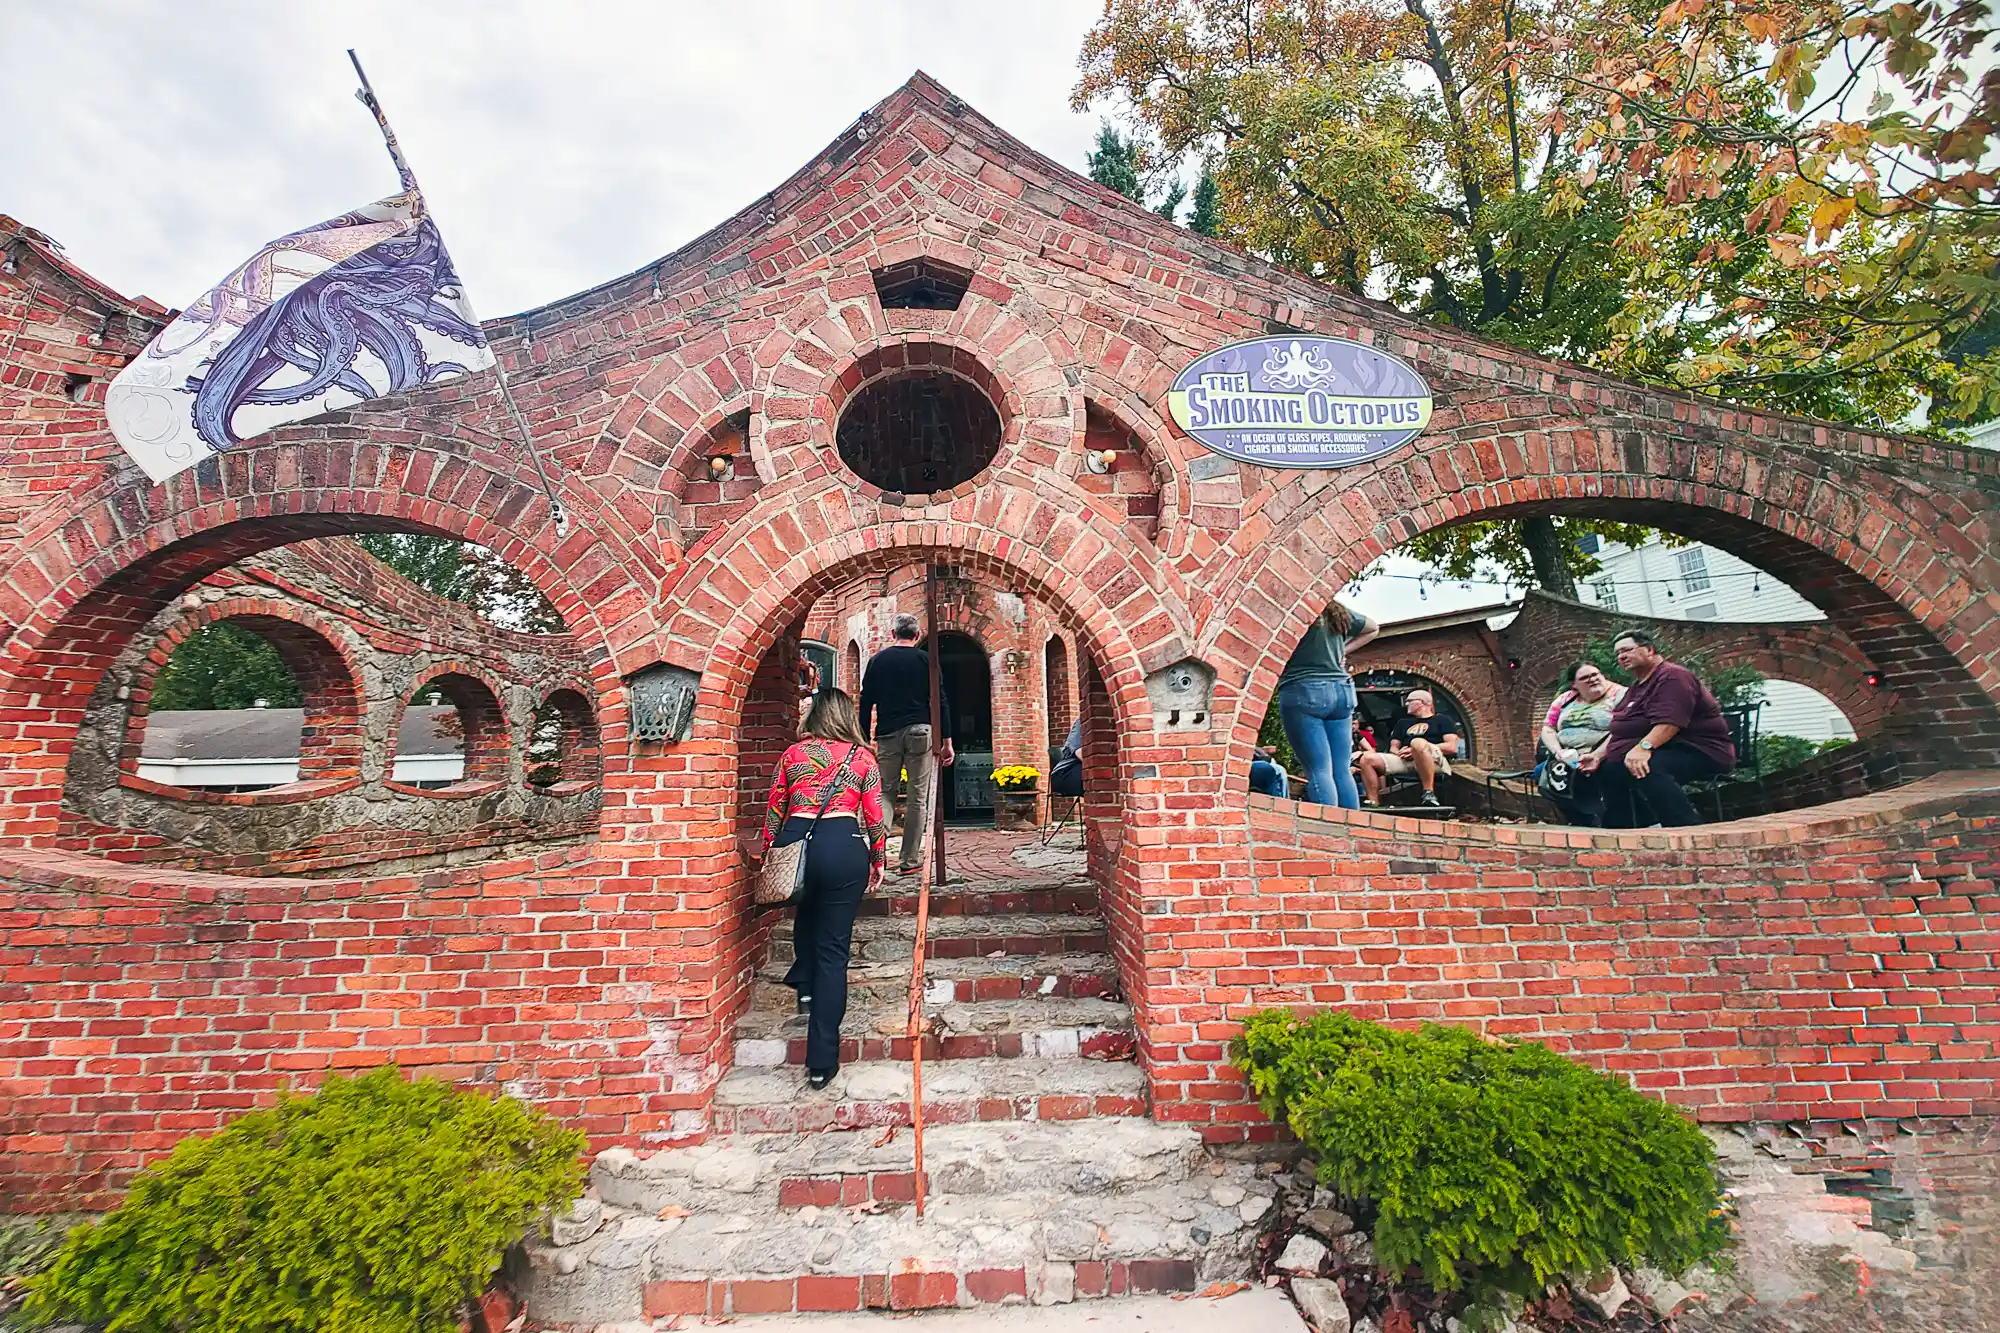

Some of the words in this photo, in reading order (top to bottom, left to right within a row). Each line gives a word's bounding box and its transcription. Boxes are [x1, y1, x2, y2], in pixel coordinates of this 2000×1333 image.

[1206, 376, 1245, 392] THE
[1188, 387, 1303, 427] SMOKING
[1308, 391, 1420, 425] OCTOPUS
[1241, 433, 1252, 443] AN
[1253, 433, 1276, 443] OCEAN
[1277, 433, 1286, 443] OF
[1288, 433, 1310, 443] GLASS
[1244, 444, 1271, 454] CIGARS
[1272, 444, 1286, 454] AND
[1287, 444, 1319, 454] SMOKING
